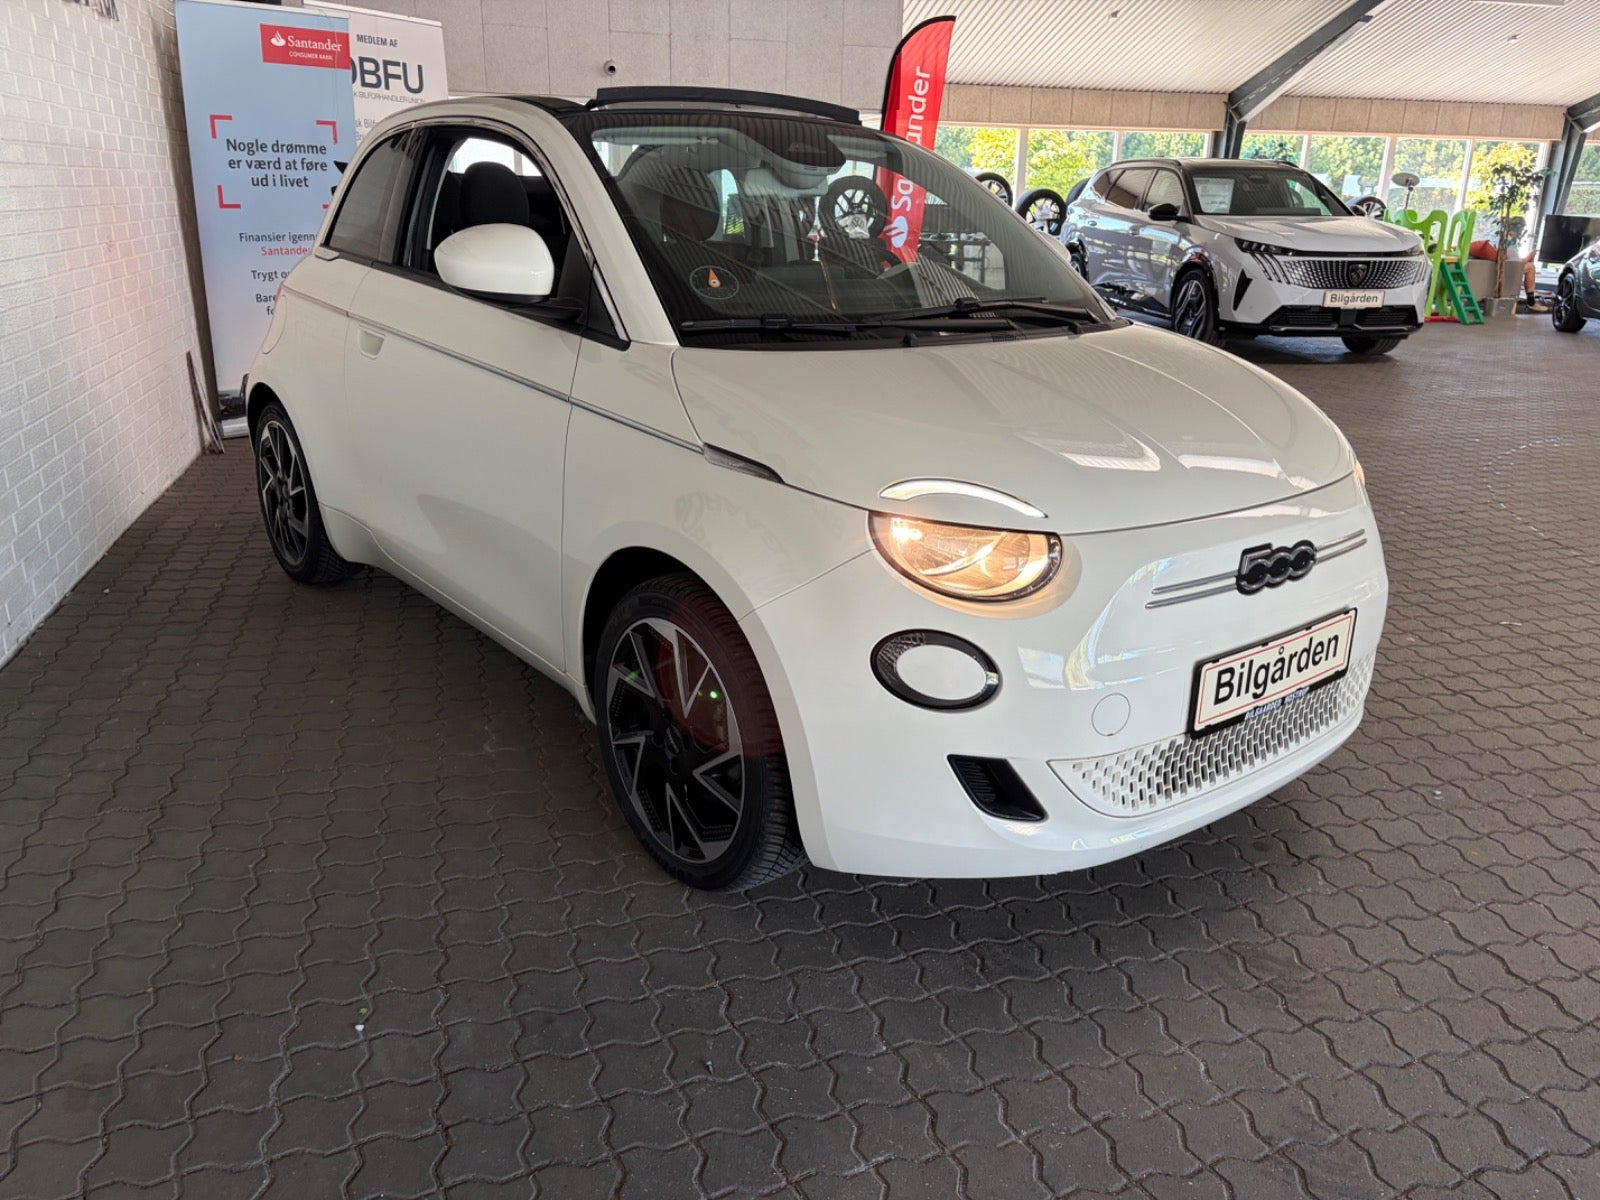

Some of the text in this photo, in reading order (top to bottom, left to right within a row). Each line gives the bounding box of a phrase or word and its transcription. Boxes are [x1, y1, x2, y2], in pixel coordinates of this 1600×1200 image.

[287, 35, 342, 51] Santander
[356, 34, 398, 47] MEDLEM AF
[289, 51, 318, 59] CONSUMER
[891, 66, 931, 212] Saander
[226, 139, 327, 156] Nogle drømme
[228, 157, 328, 171] er værd at føre
[251, 174, 309, 187] ud i livet
[239, 232, 286, 242] Finansier
[251, 270, 290, 282] Trygt o
[1330, 292, 1378, 305] Bilgården
[1236, 540, 1317, 595] 500
[1213, 633, 1340, 706] Bilgården
